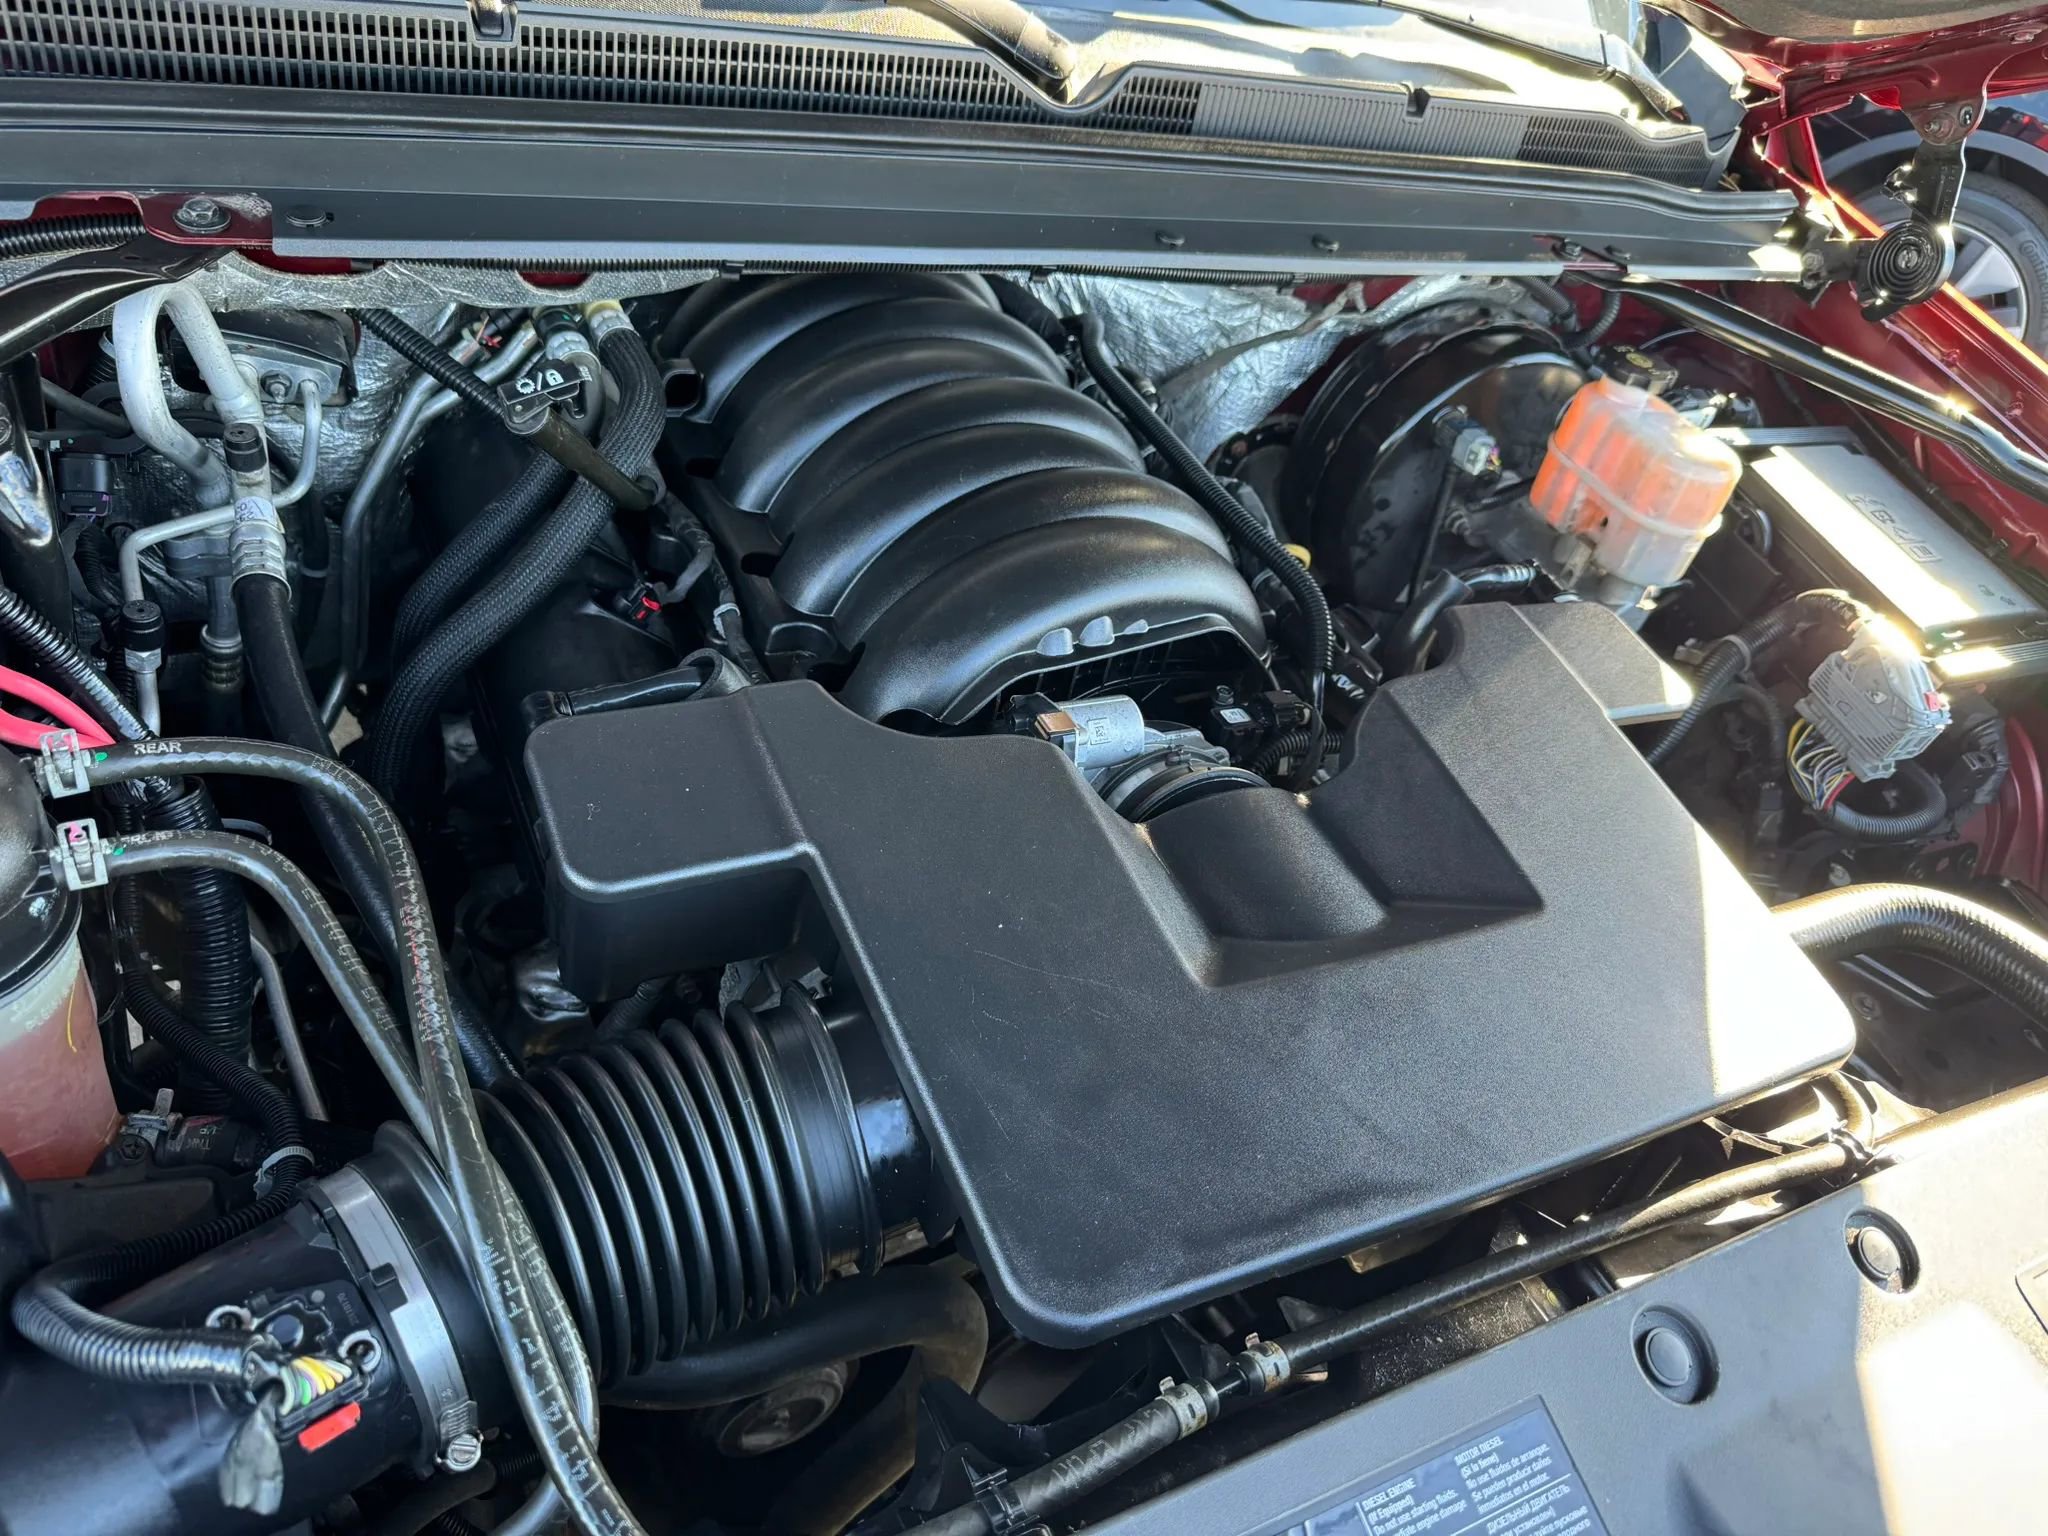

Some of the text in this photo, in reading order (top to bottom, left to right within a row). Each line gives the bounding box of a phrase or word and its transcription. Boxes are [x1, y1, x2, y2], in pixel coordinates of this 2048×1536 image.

[133, 741, 182, 755] REAR
[1454, 1436, 1504, 1466] MOTOR DIESEL
[1461, 1466, 1472, 1480] (Si
[1478, 1452, 1500, 1469] tiene)
[1466, 1478, 1477, 1490] No
[1477, 1473, 1490, 1484] use
[1488, 1462, 1512, 1478] fluidos
[1510, 1457, 1521, 1467] de
[1362, 1478, 1416, 1511] DIESEL ENGINE
[1472, 1490, 1482, 1502] Se
[1482, 1479, 1507, 1499] pueden
[1506, 1466, 1532, 1487] producir
[1377, 1494, 1415, 1519] Equipped)
[1477, 1491, 1514, 1514] inmediatos
[1513, 1486, 1523, 1496] en
[1384, 1517, 1398, 1531] not
[1397, 1512, 1412, 1525] use
[1410, 1500, 1438, 1518] starting
[1416, 1513, 1440, 1530] engine
